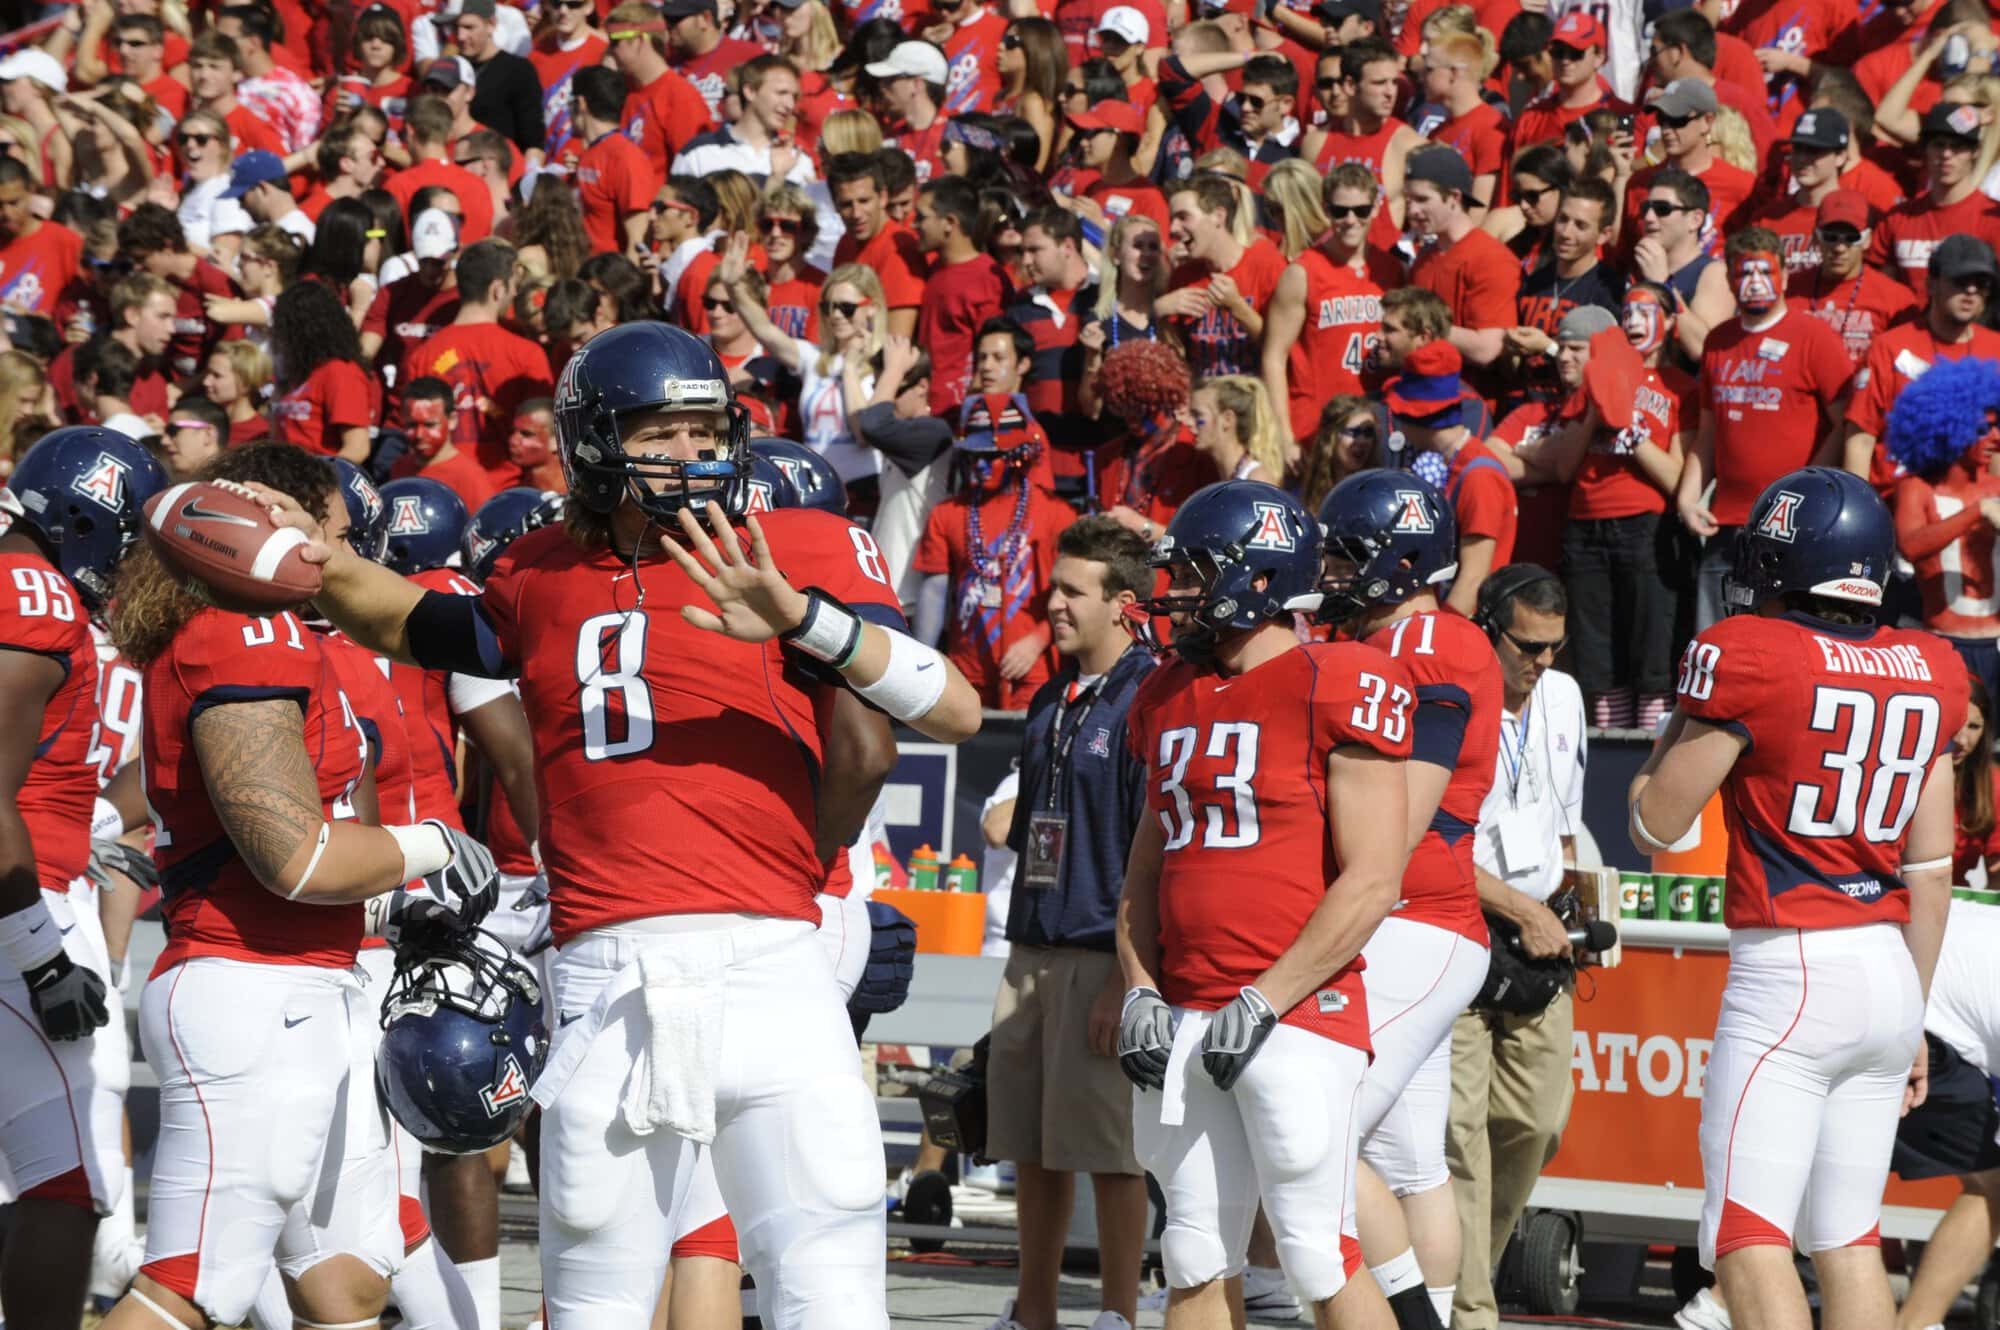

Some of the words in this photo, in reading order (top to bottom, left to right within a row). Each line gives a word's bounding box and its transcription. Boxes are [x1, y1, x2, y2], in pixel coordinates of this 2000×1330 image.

[72, 451, 133, 514] A
[388, 496, 430, 536] A
[1246, 501, 1295, 553] A
[1392, 489, 1434, 534] A
[1757, 489, 1805, 544] A
[190, 529, 238, 559] COLLEGIATE
[848, 526, 887, 584] 8
[11, 567, 75, 622] 95
[1389, 613, 1436, 658] 71
[576, 610, 656, 762] 8
[1677, 639, 1721, 701] 38
[1351, 671, 1412, 744] 33
[1087, 727, 1110, 758] A
[1786, 684, 1941, 844] 38
[1159, 720, 1261, 852] 33
[479, 1053, 530, 1118] A
